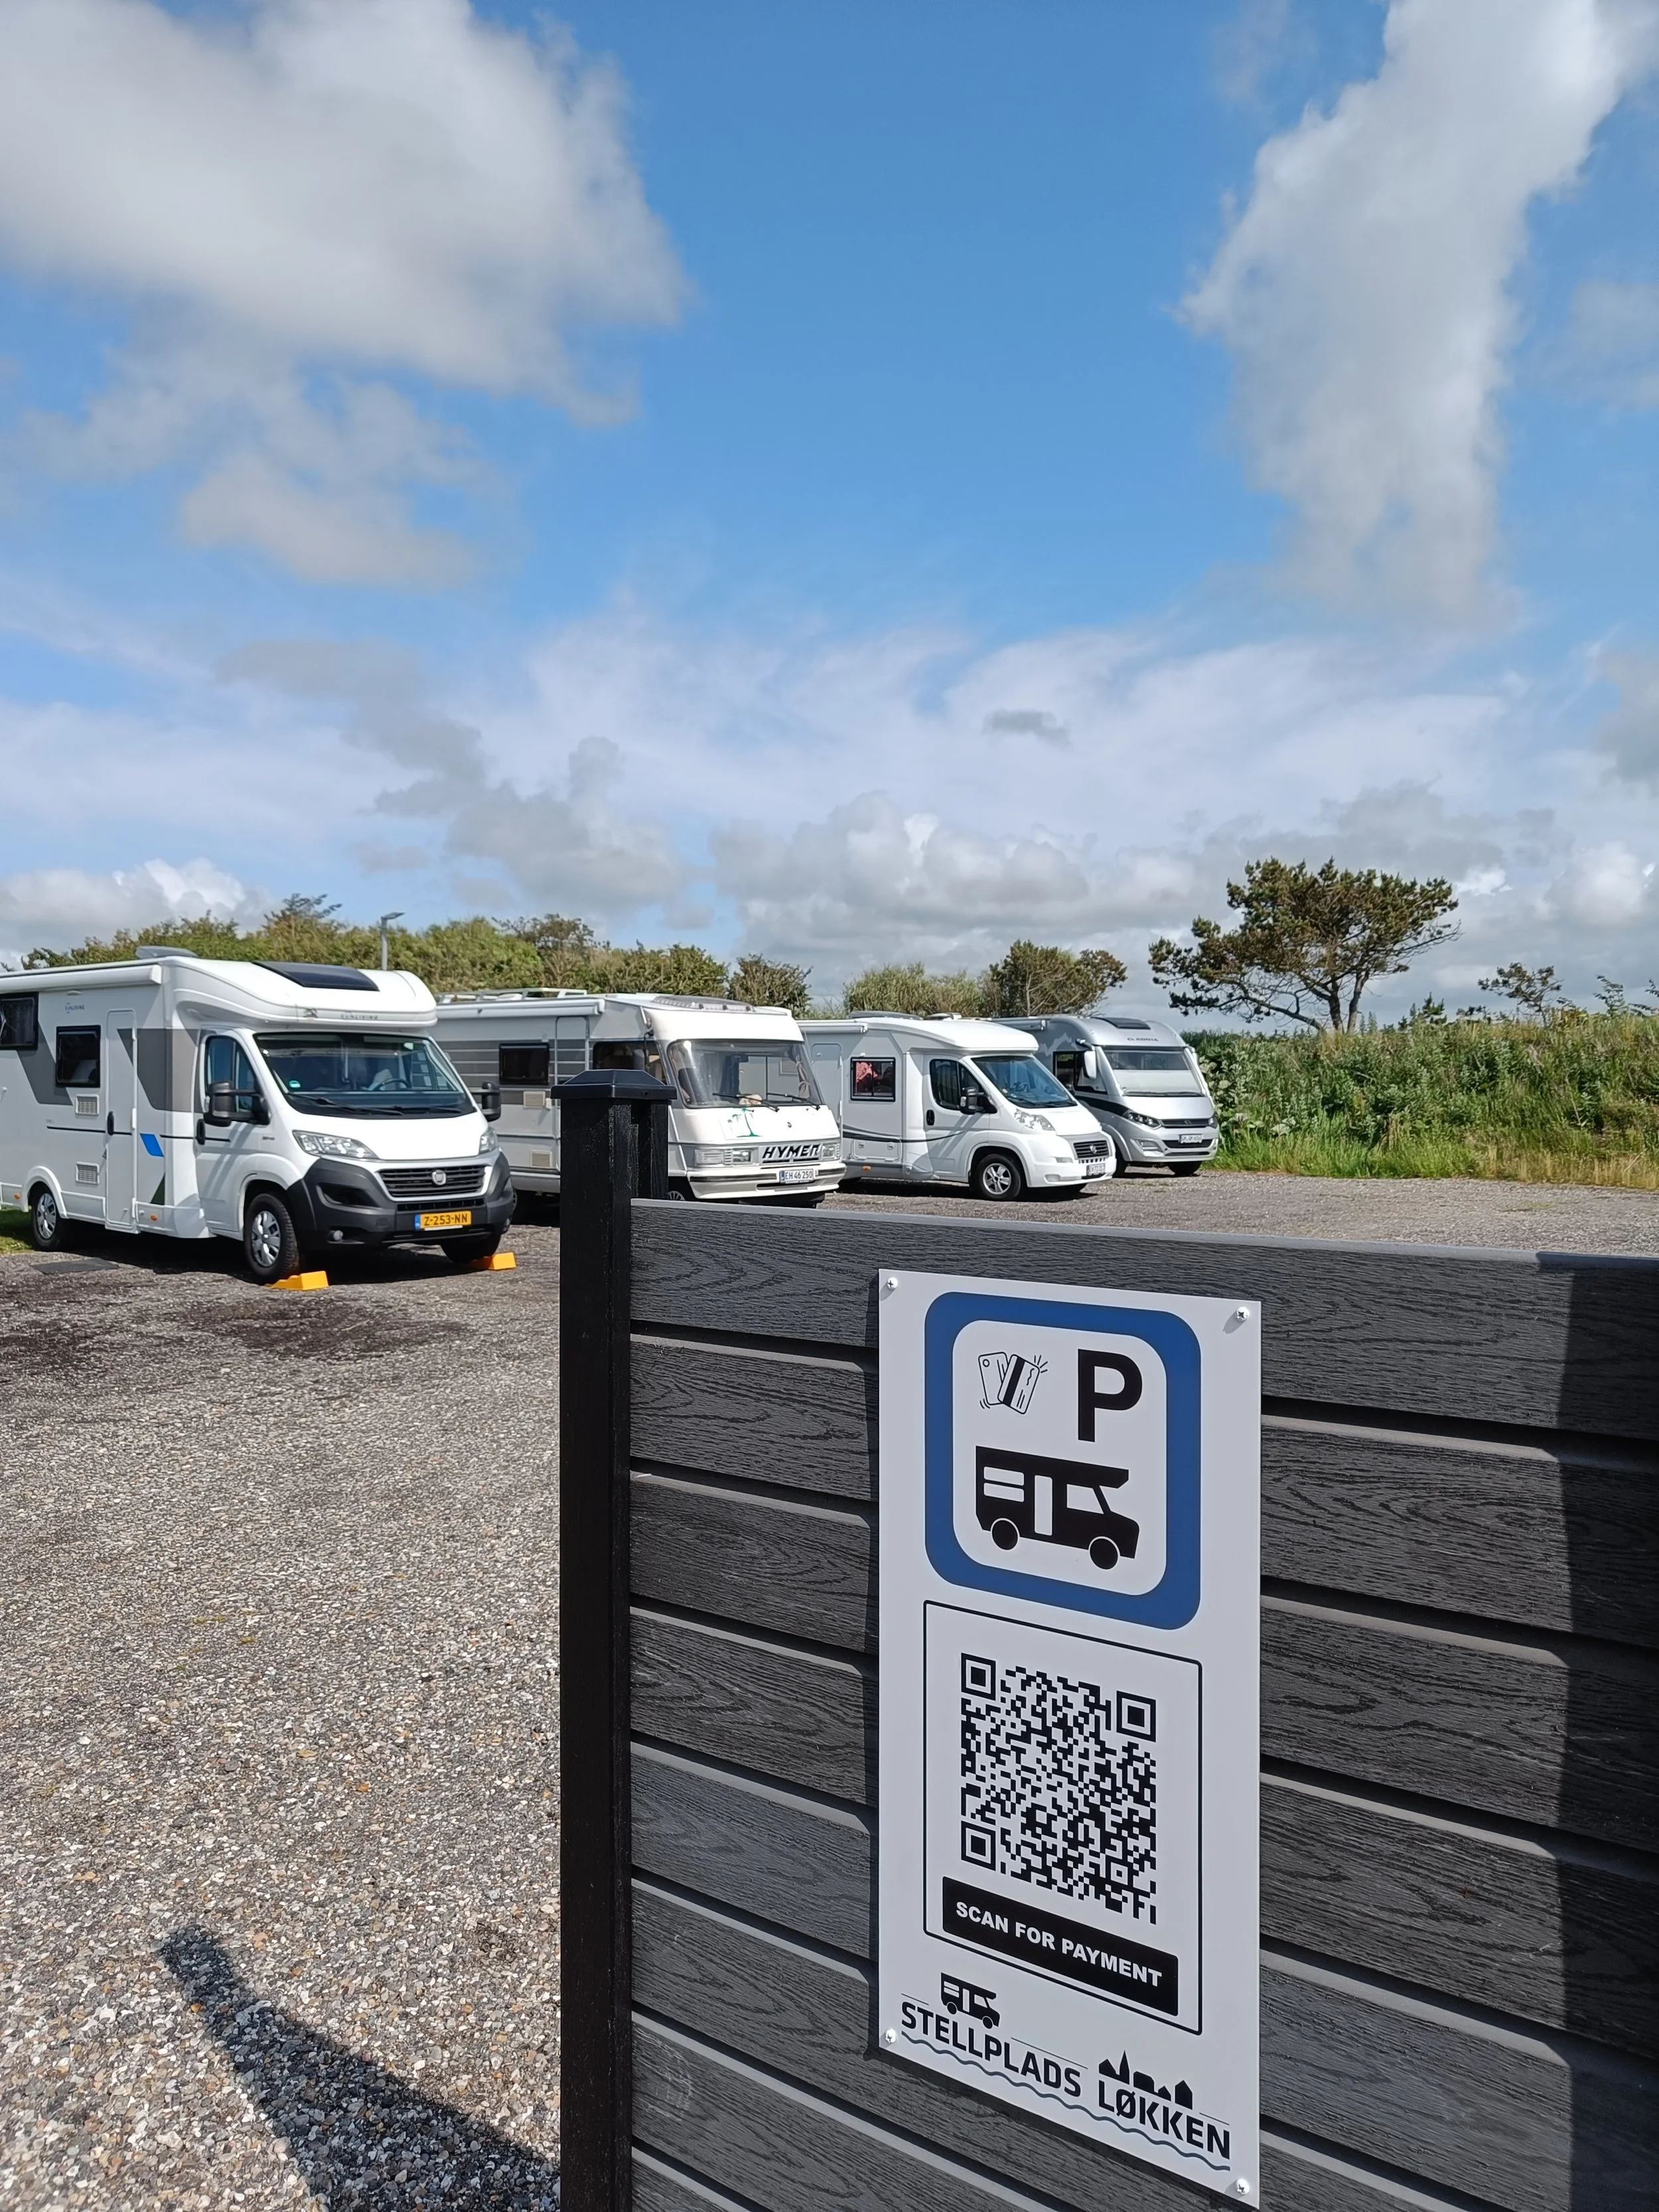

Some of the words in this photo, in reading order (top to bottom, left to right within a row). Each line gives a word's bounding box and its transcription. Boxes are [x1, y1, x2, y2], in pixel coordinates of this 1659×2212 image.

[785, 1171, 793, 1180] EH
[802, 1171, 812, 1179] 250
[424, 1213, 468, 1226] Z-253-NN
[1078, 1349, 1143, 1443] P
[956, 1901, 1009, 1933] SCAN
[1015, 1921, 1056, 1951] FOR
[1062, 1938, 1162, 1988] PAYMENT
[901, 2002, 1082, 2097] STELLPLADS
[1098, 2080, 1230, 2160] LØKKEN
